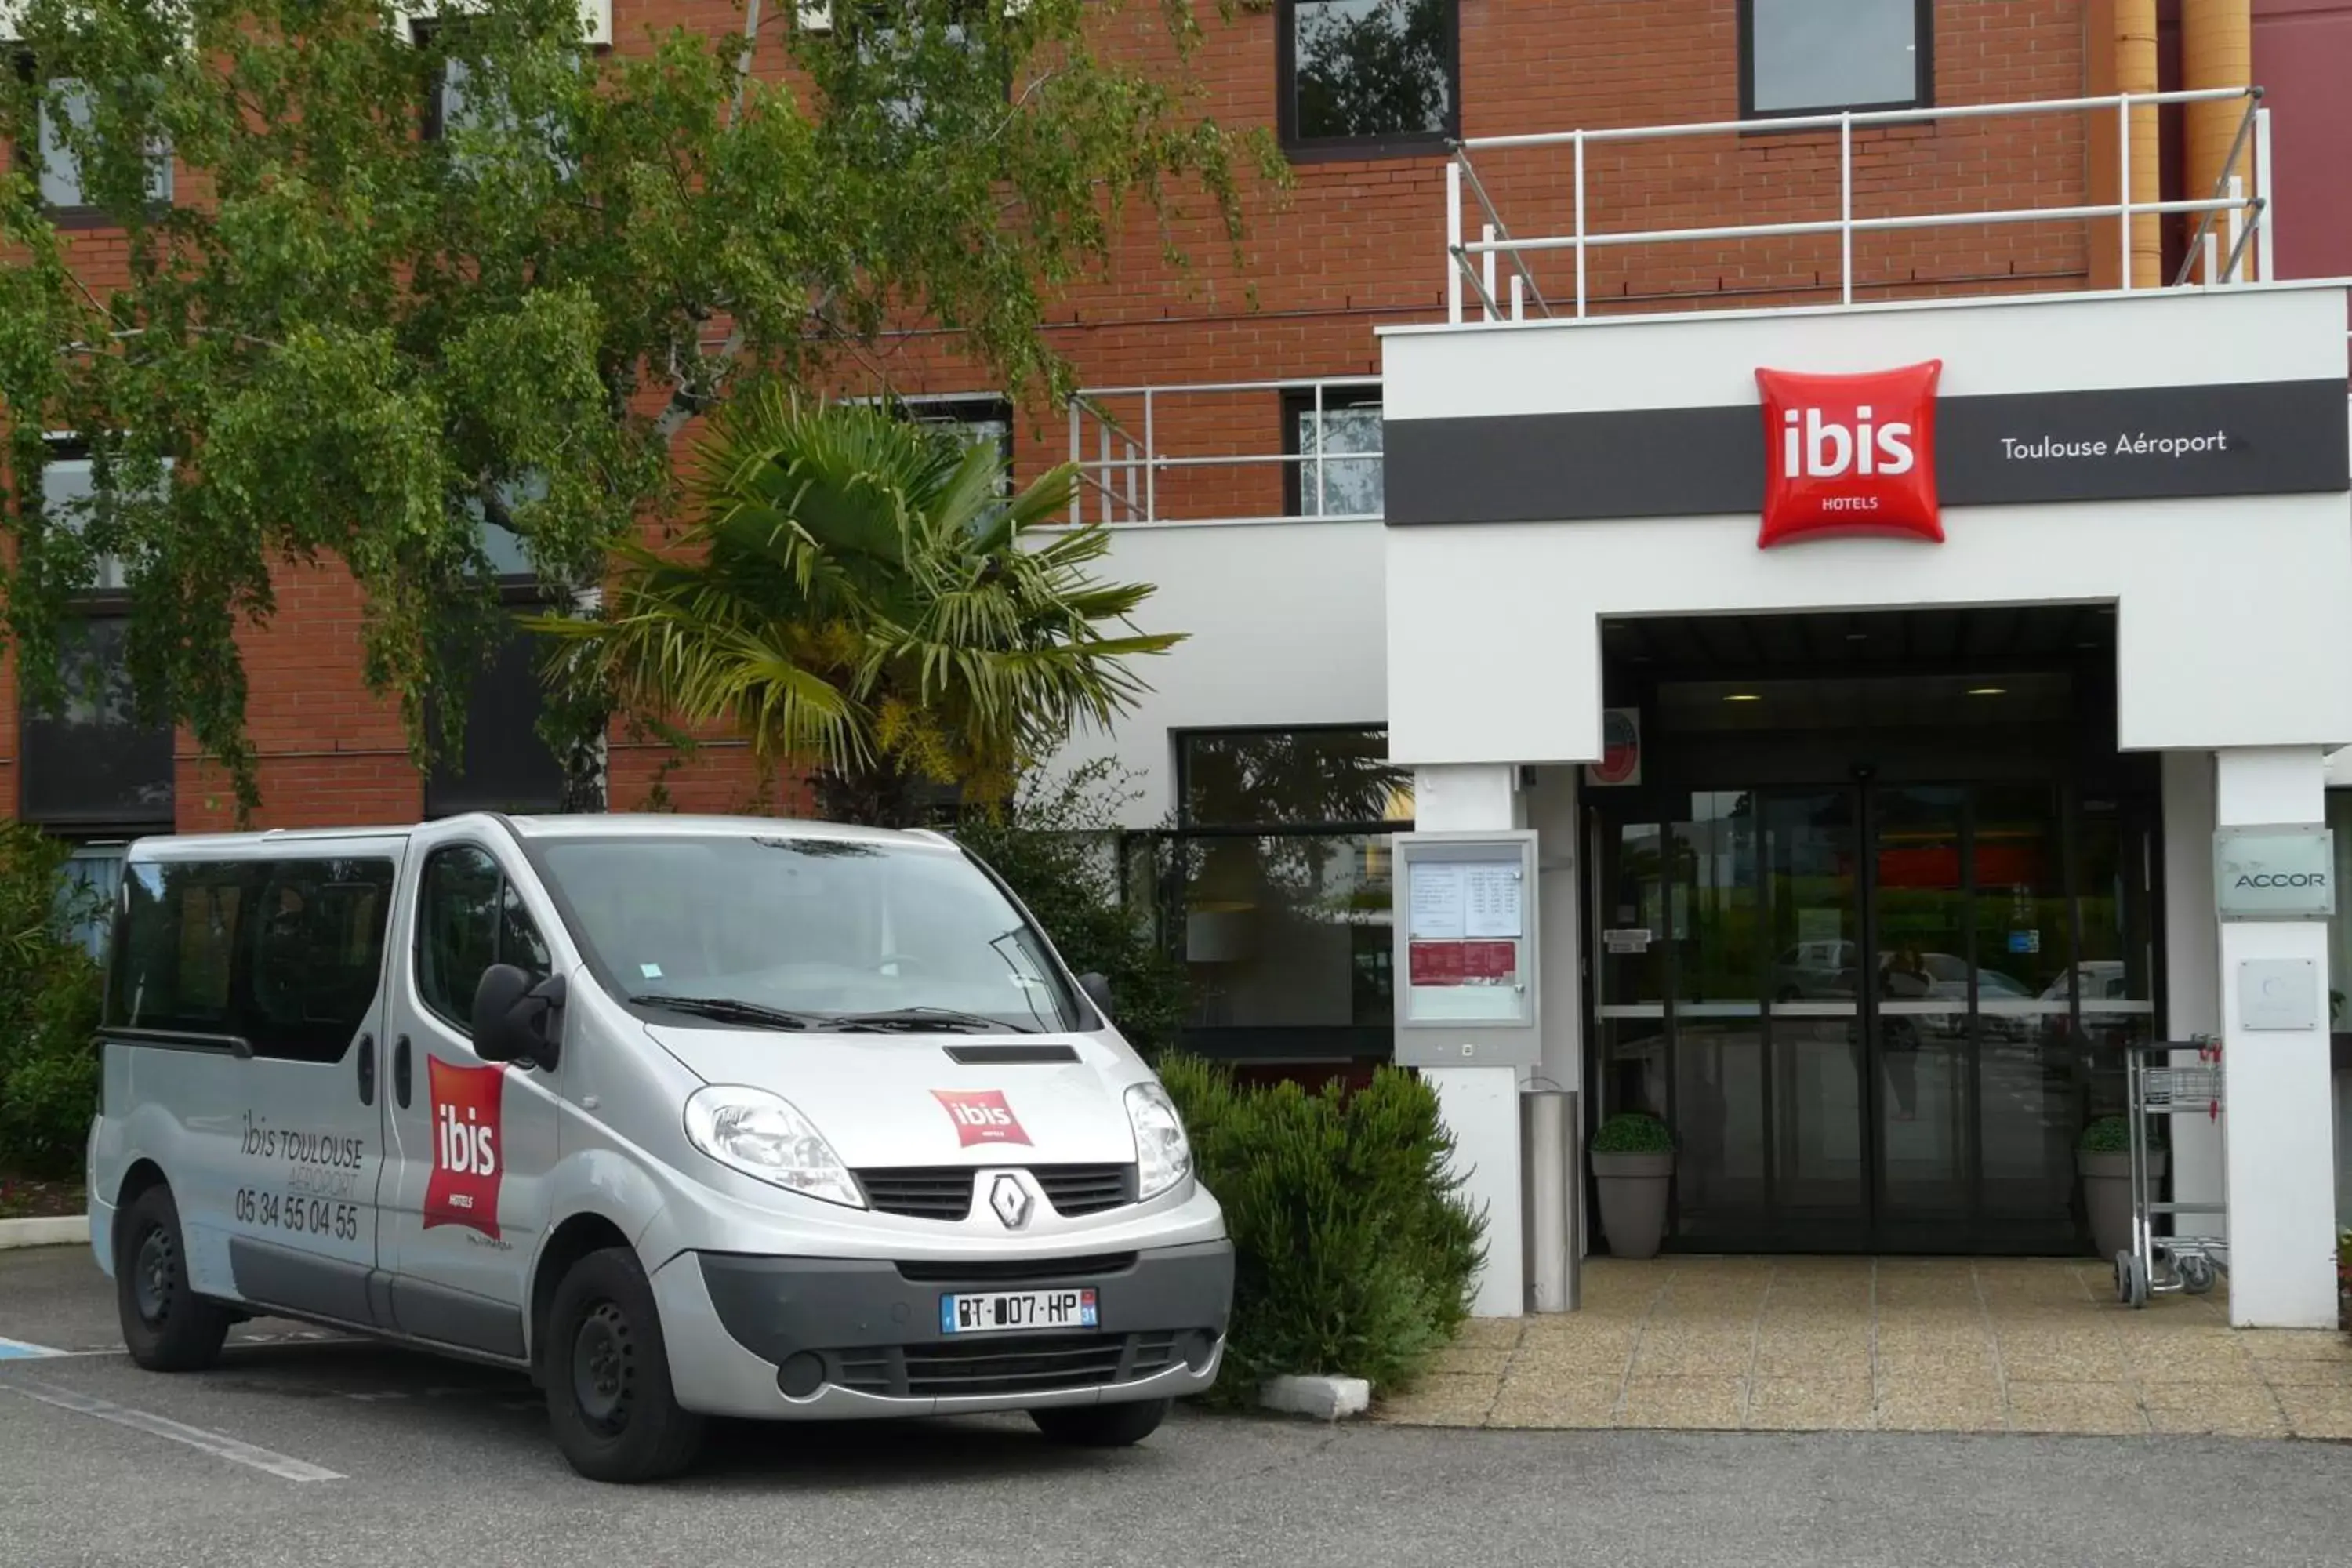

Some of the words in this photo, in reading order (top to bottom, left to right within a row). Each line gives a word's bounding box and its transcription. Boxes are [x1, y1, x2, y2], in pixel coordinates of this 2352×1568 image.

[1784, 405, 1915, 478] ibis
[2001, 435, 2108, 459] Toulouse
[2115, 430, 2227, 459] Aéroport
[1821, 496, 1879, 510] HOTELS
[2234, 872, 2326, 889] ACCOR
[950, 1102, 1011, 1126] ibis
[241, 1109, 275, 1157] ibis
[280, 1130, 364, 1170] TOULOUSE
[439, 1102, 495, 1176] ibis
[237, 1188, 256, 1225] 05
[260, 1192, 279, 1229] 34
[284, 1196, 305, 1232] 55
[310, 1200, 330, 1236] 04
[336, 1203, 358, 1241] 55
